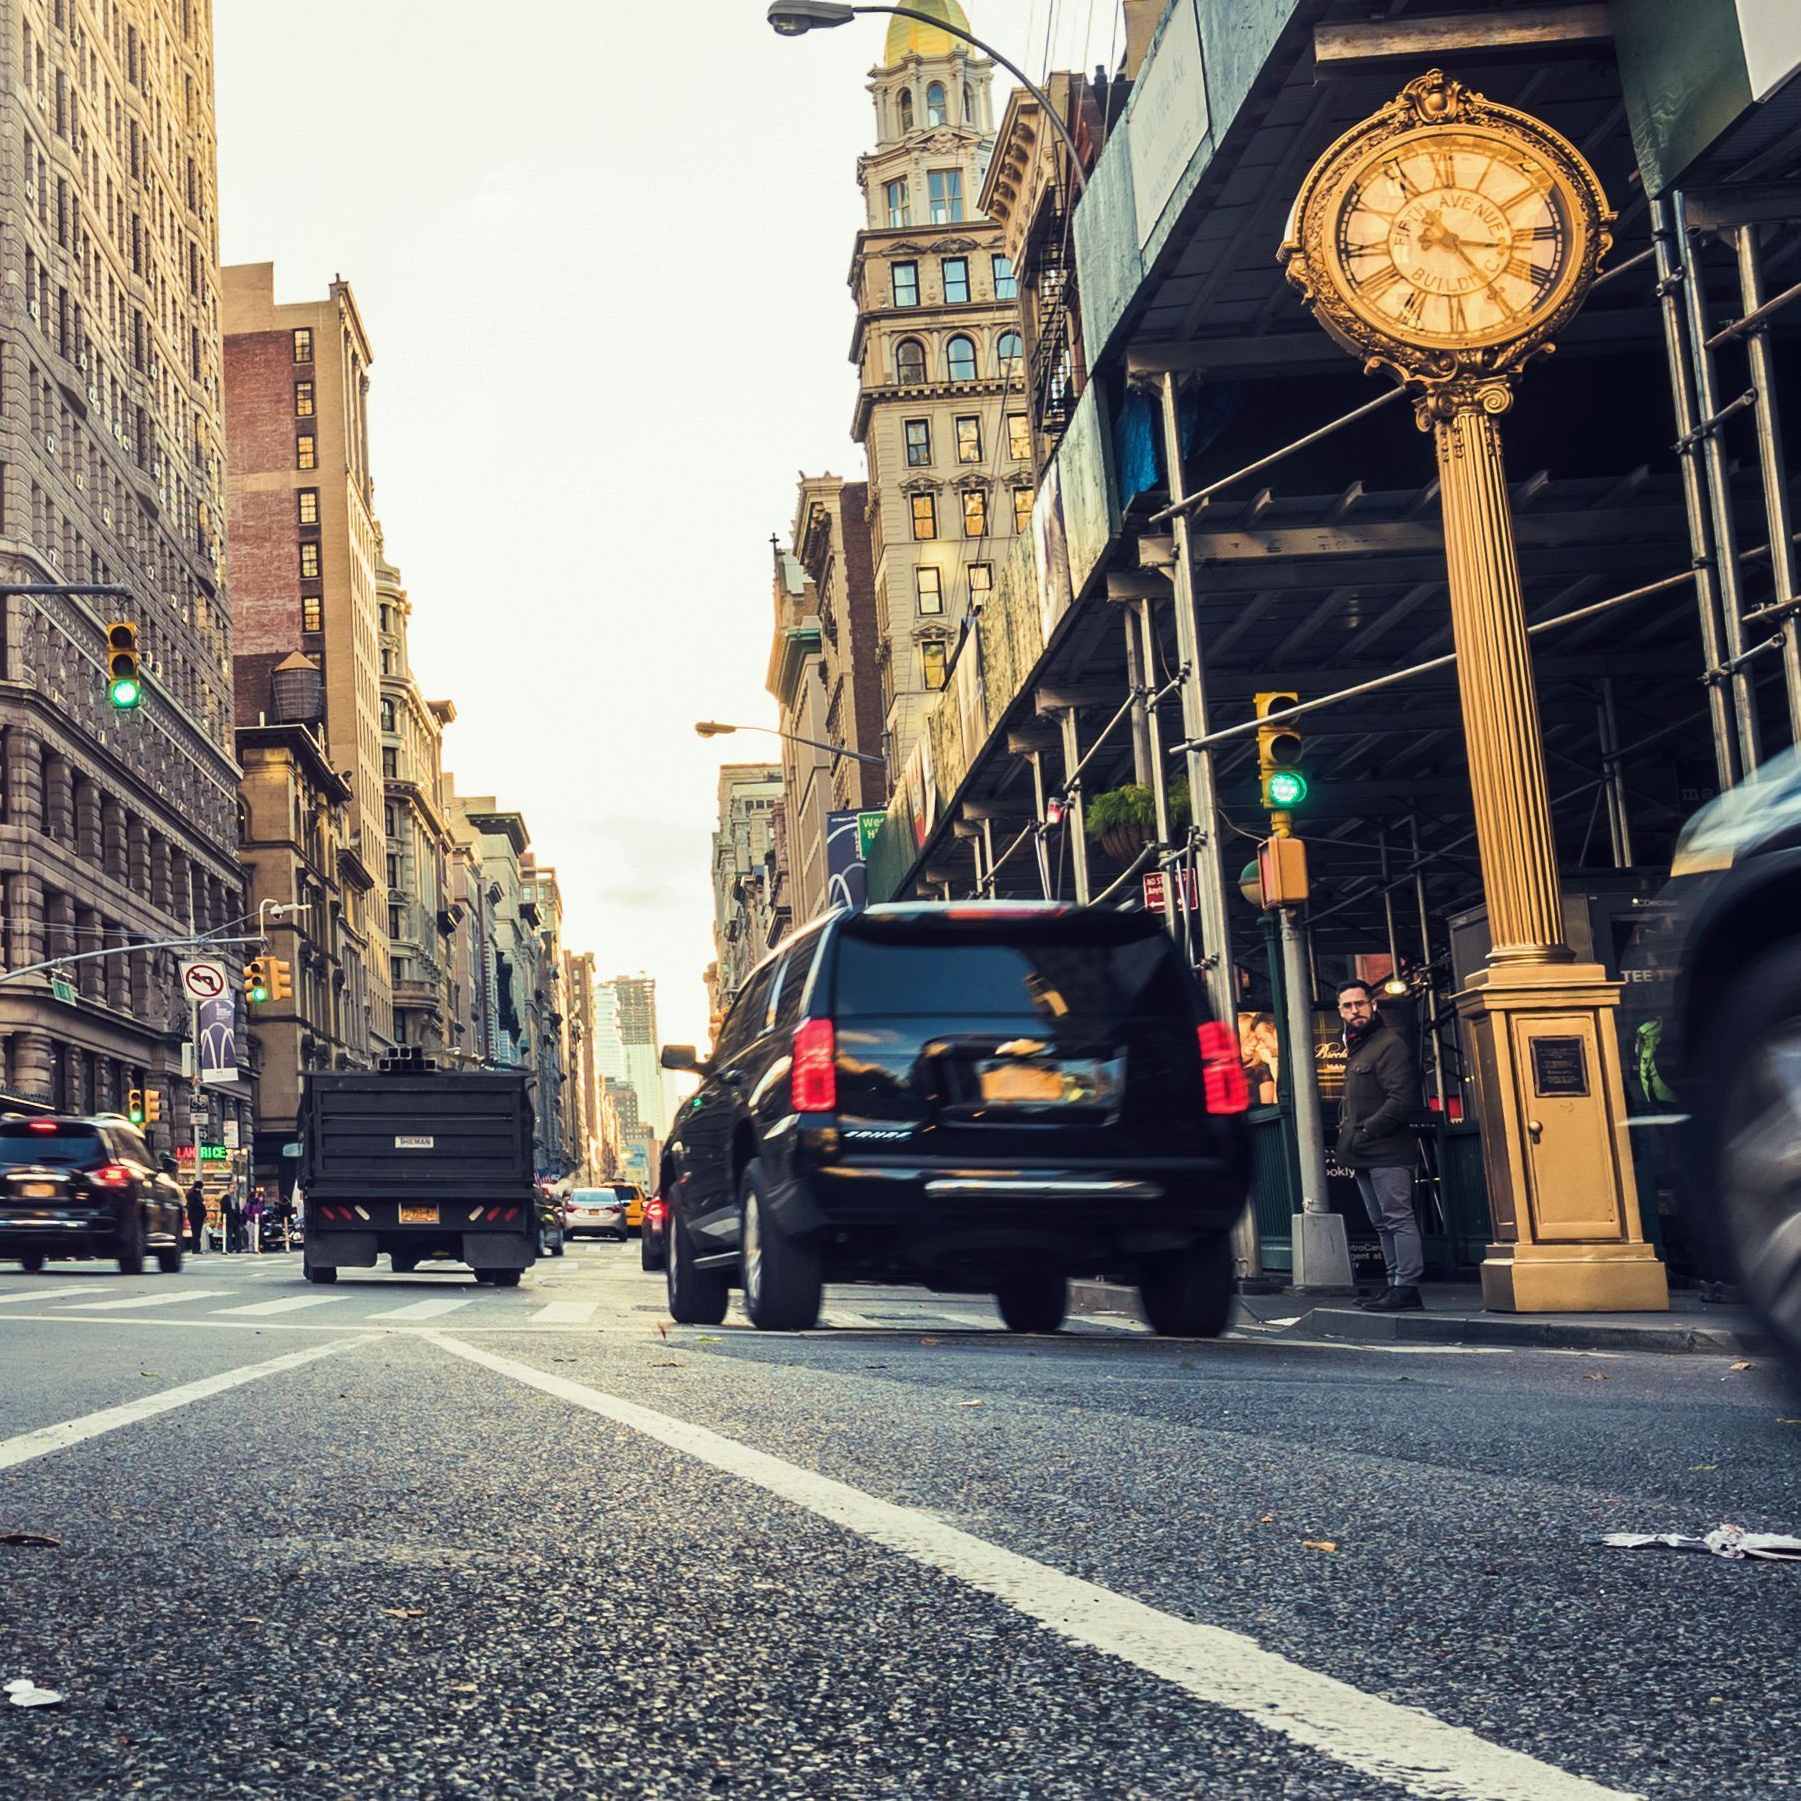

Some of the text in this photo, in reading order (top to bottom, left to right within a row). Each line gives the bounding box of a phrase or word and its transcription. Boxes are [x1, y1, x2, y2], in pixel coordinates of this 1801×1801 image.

[1395, 195, 1504, 245] FIFTH AVENUE
[1412, 262, 1500, 291] BUILDIG
